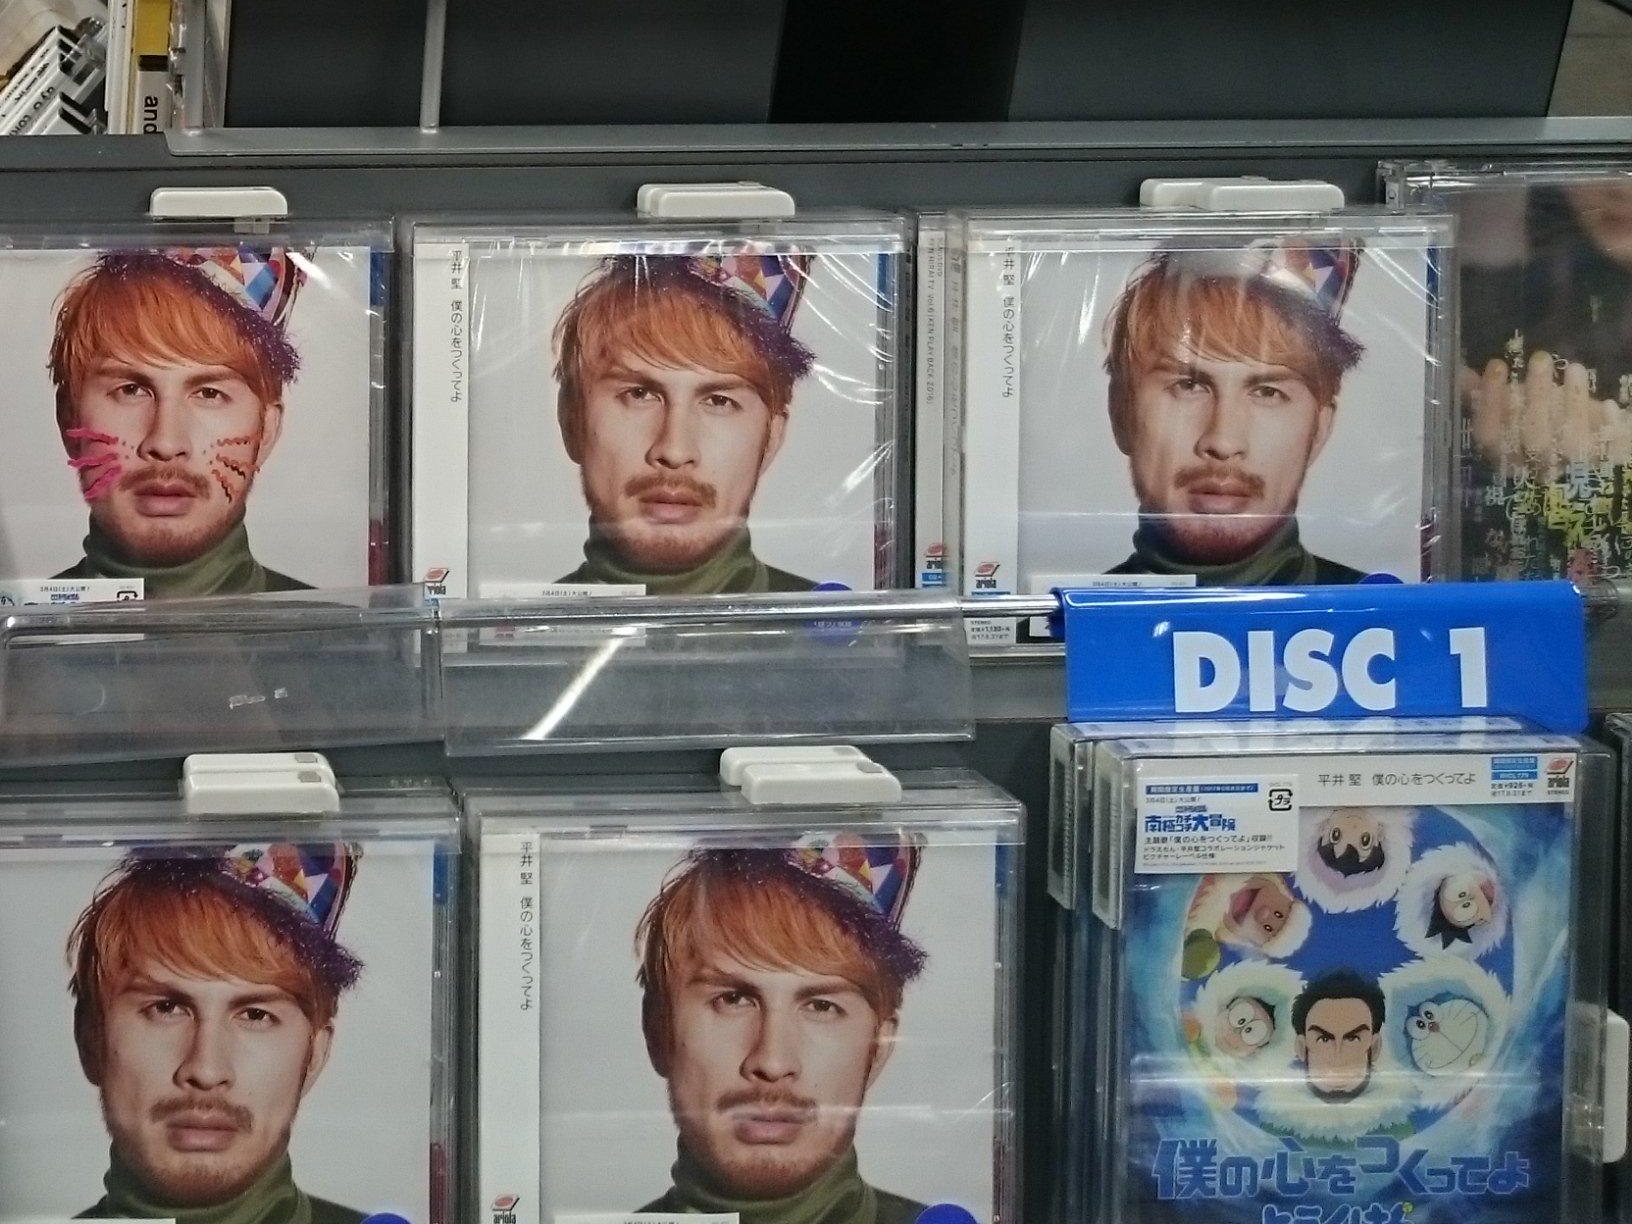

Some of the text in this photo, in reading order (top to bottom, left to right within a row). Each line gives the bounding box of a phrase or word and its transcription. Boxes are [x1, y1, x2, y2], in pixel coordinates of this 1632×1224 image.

[1173, 627, 1487, 712] DISC 1
[1372, 772, 1476, 786] 僕の心をつくってよ
[520, 896, 534, 1011] 僕の心をつくってよ
[1152, 1135, 1530, 1200] 僕の心をつくってよ
